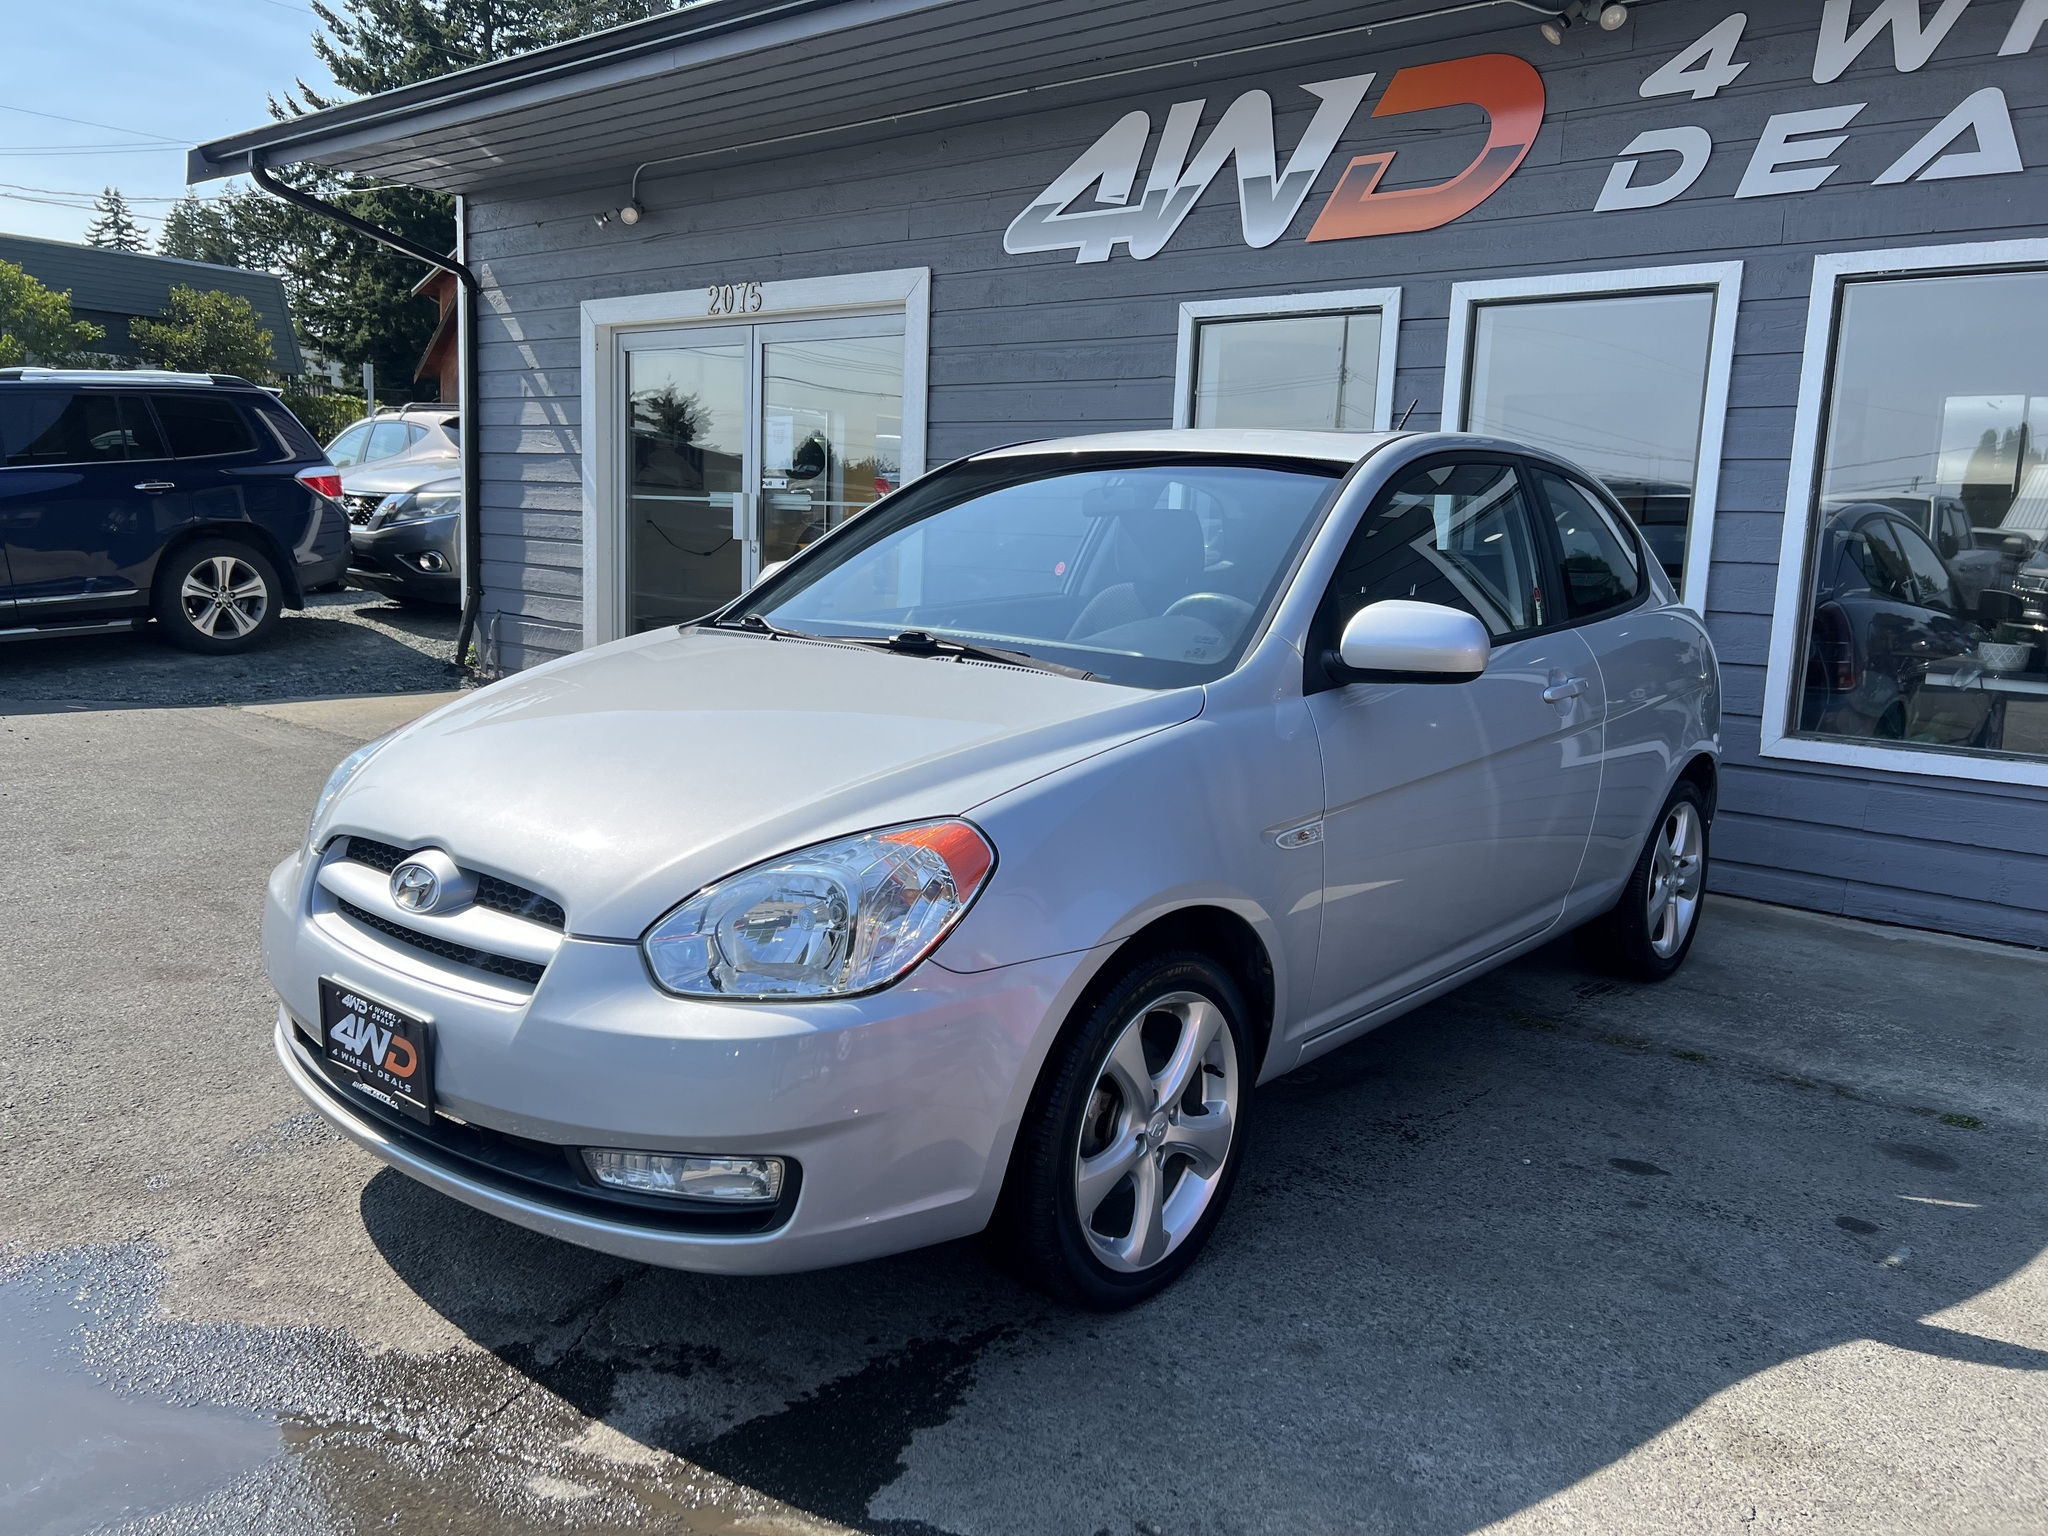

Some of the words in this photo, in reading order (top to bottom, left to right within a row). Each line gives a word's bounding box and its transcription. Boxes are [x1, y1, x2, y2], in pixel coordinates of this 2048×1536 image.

[1639, 12, 1750, 100] 4
[1812, 0, 2048, 84] W
[1594, 86, 2024, 212] DEA
[707, 281, 763, 316] 2075
[374, 1006, 397, 1022] WHEEL
[332, 1048, 338, 1056] 4
[341, 1051, 374, 1074] WHEEL
[377, 1069, 412, 1094] DEALS
